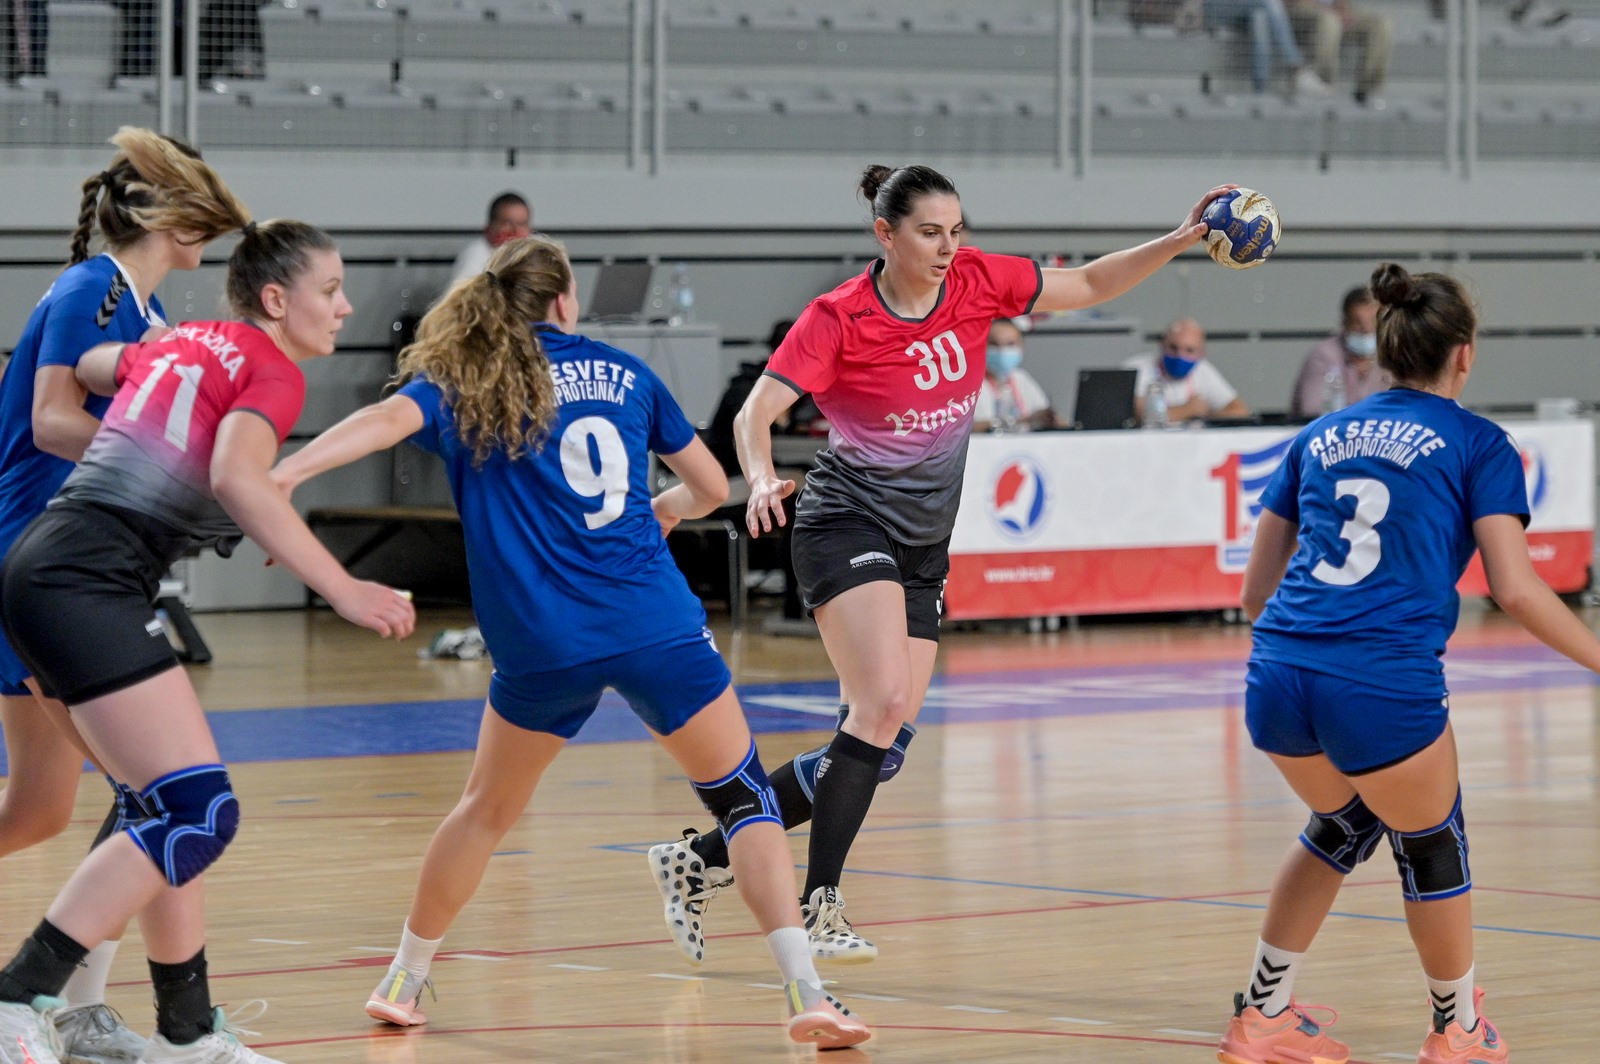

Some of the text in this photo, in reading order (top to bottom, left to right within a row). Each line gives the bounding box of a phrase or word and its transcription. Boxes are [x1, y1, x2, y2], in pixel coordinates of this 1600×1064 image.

[549, 360, 636, 390] ESVETE
[905, 330, 967, 390] 30
[124, 353, 204, 453] 11
[553, 380, 626, 406] PROTEINKA
[1309, 419, 1447, 457] RK SESVETE
[1320, 437, 1419, 470] AGROPROTEINKA
[560, 416, 629, 530] 9
[1311, 478, 1390, 585] 3
